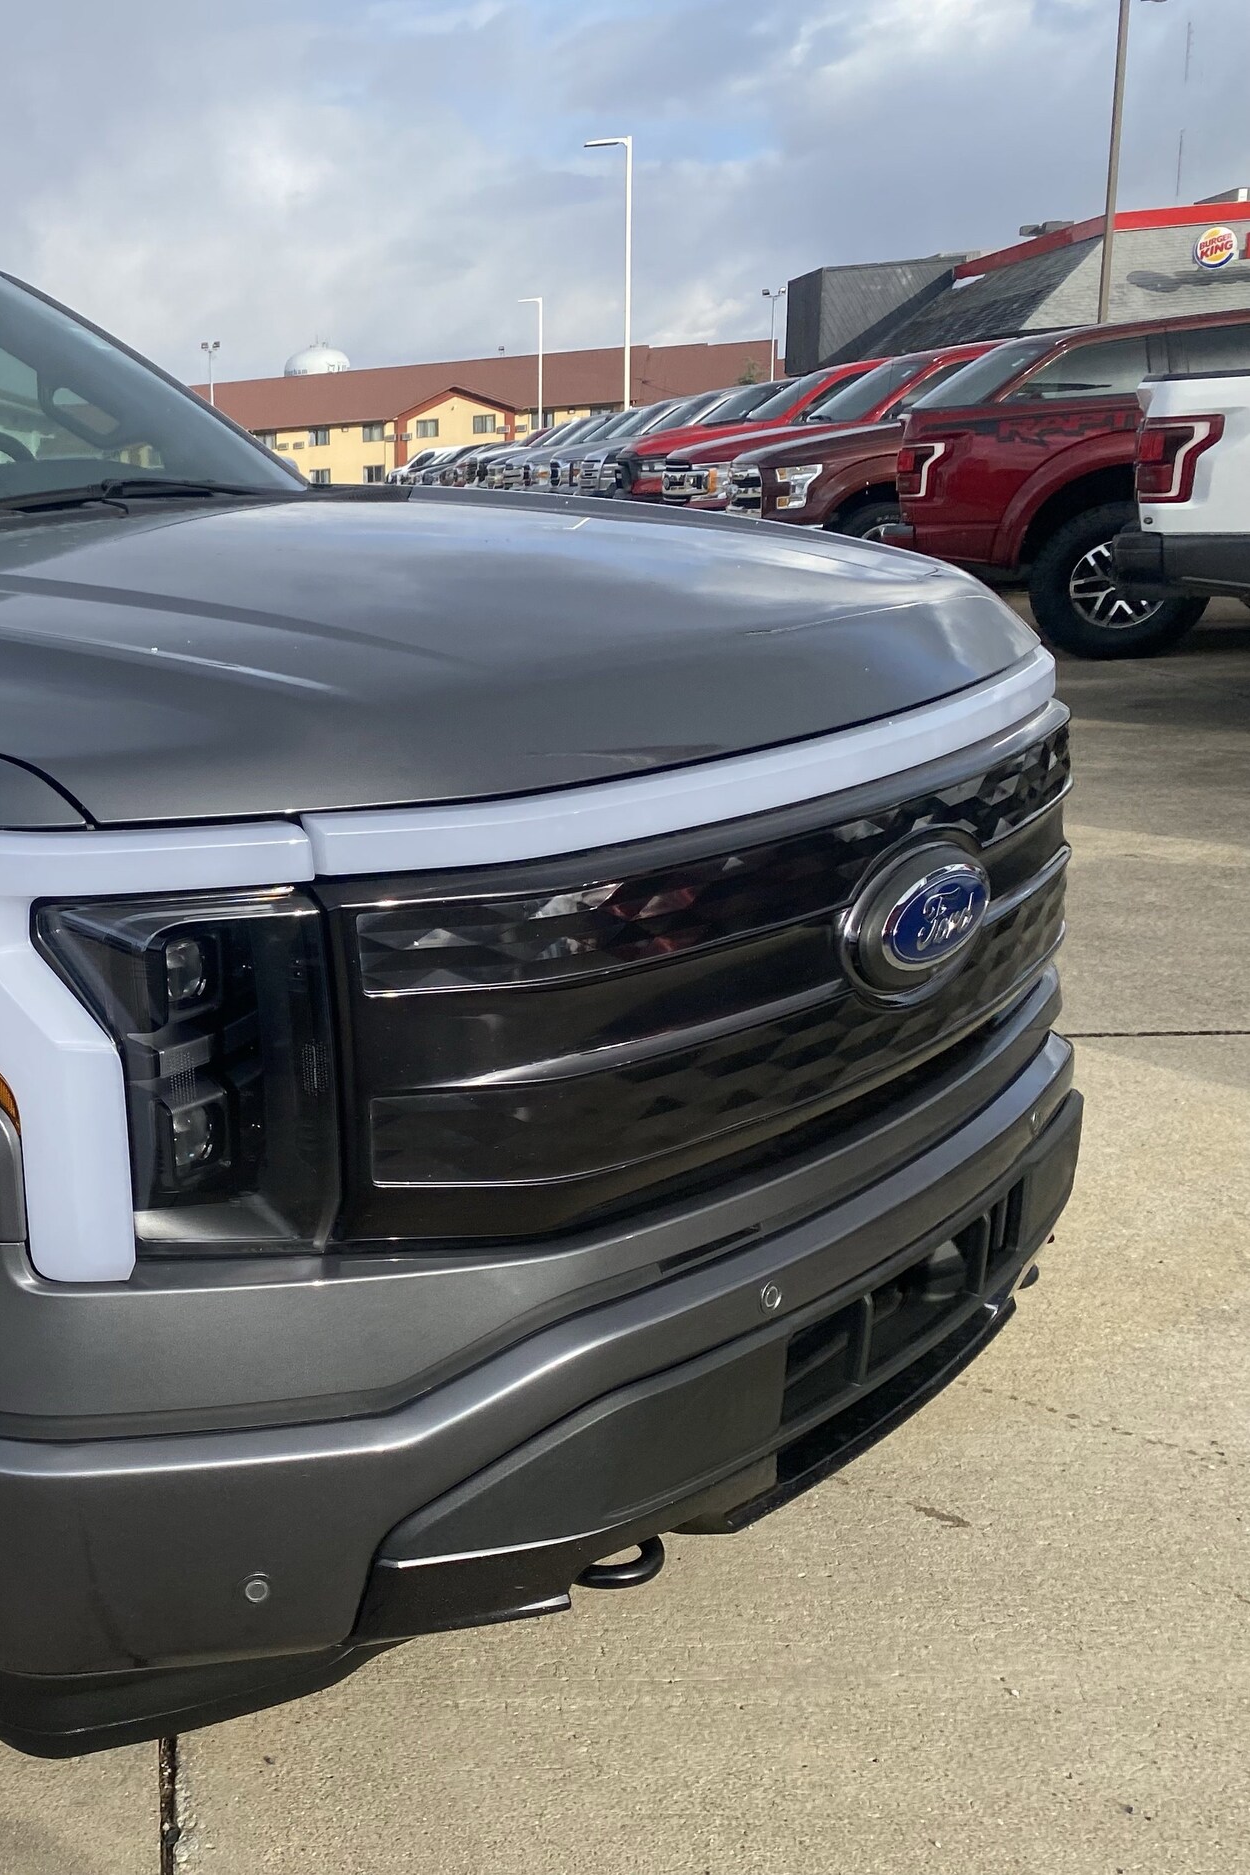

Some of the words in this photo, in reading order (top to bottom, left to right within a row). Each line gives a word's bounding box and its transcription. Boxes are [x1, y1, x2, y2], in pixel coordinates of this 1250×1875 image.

[1199, 233, 1232, 250] BURGER
[1200, 241, 1233, 260] KING
[997, 408, 1143, 446] RAPT
[916, 887, 975, 951] Ford
